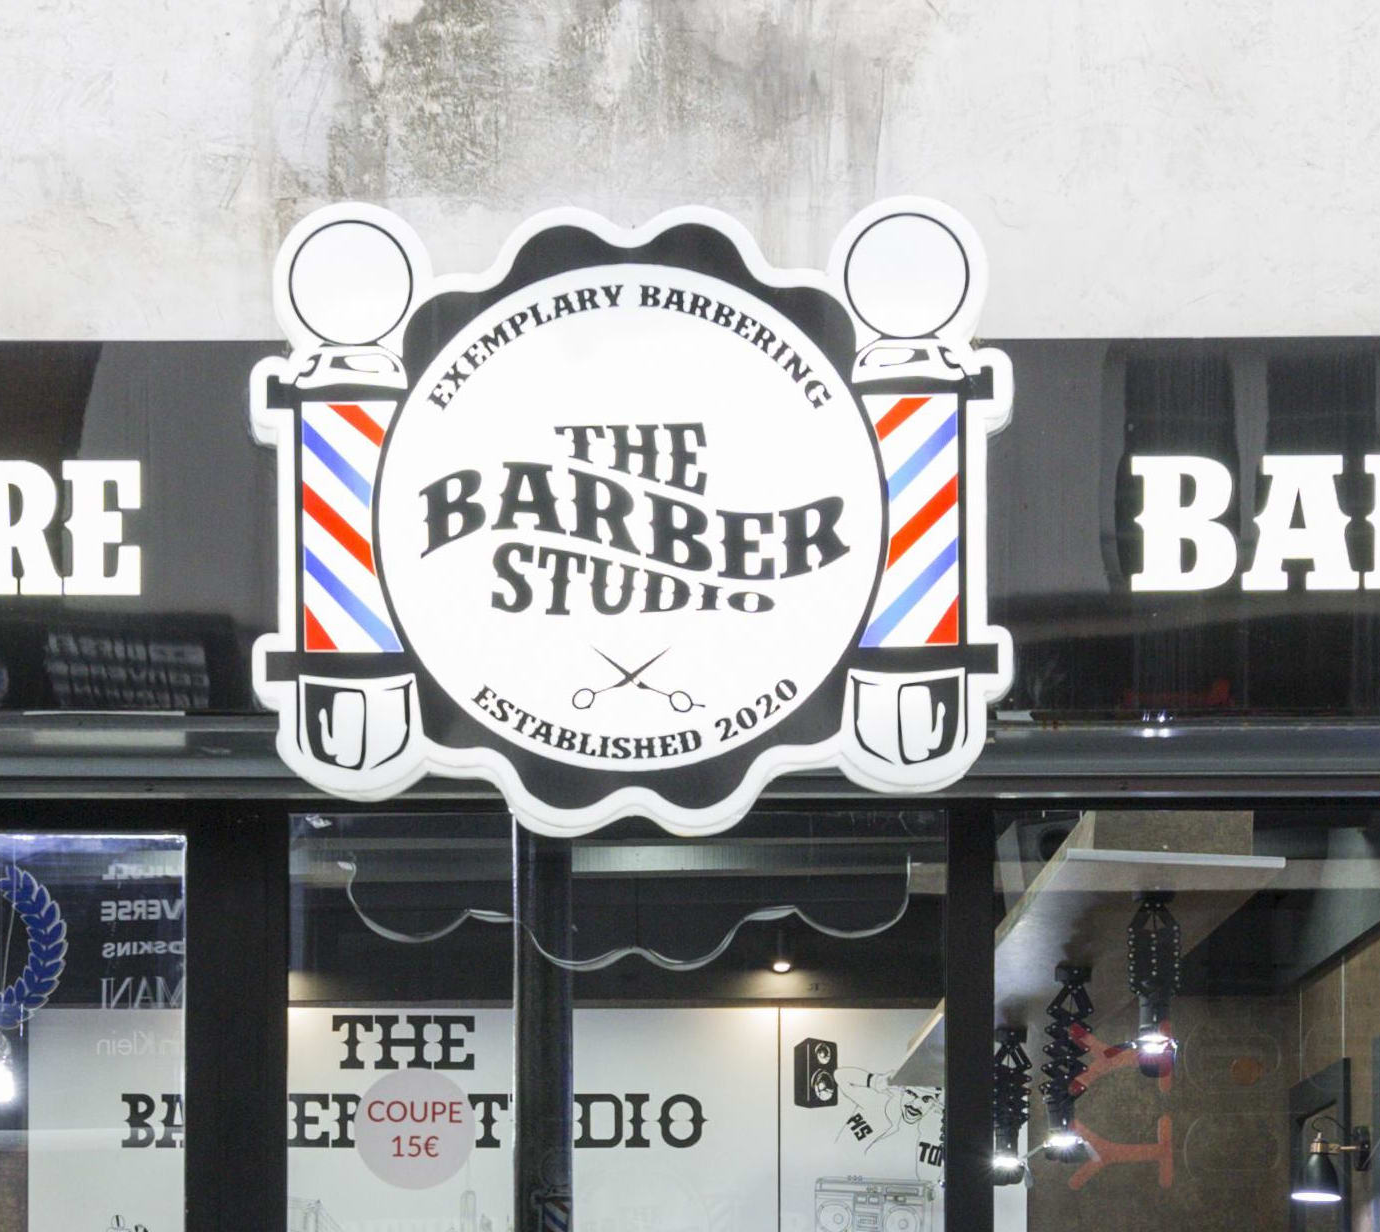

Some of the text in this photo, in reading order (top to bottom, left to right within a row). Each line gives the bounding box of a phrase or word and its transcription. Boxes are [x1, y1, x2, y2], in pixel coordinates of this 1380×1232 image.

[427, 284, 832, 411] EXEMPLARY BARBERING
[555, 422, 707, 495] THE
[419, 461, 851, 580] BARBER
[491, 542, 775, 616] STUDIO
[471, 680, 799, 760] ESTABLISHED 2020
[332, 1015, 476, 1071] THE
[367, 1100, 464, 1125] COUPE
[391, 1134, 440, 1159] 15€
